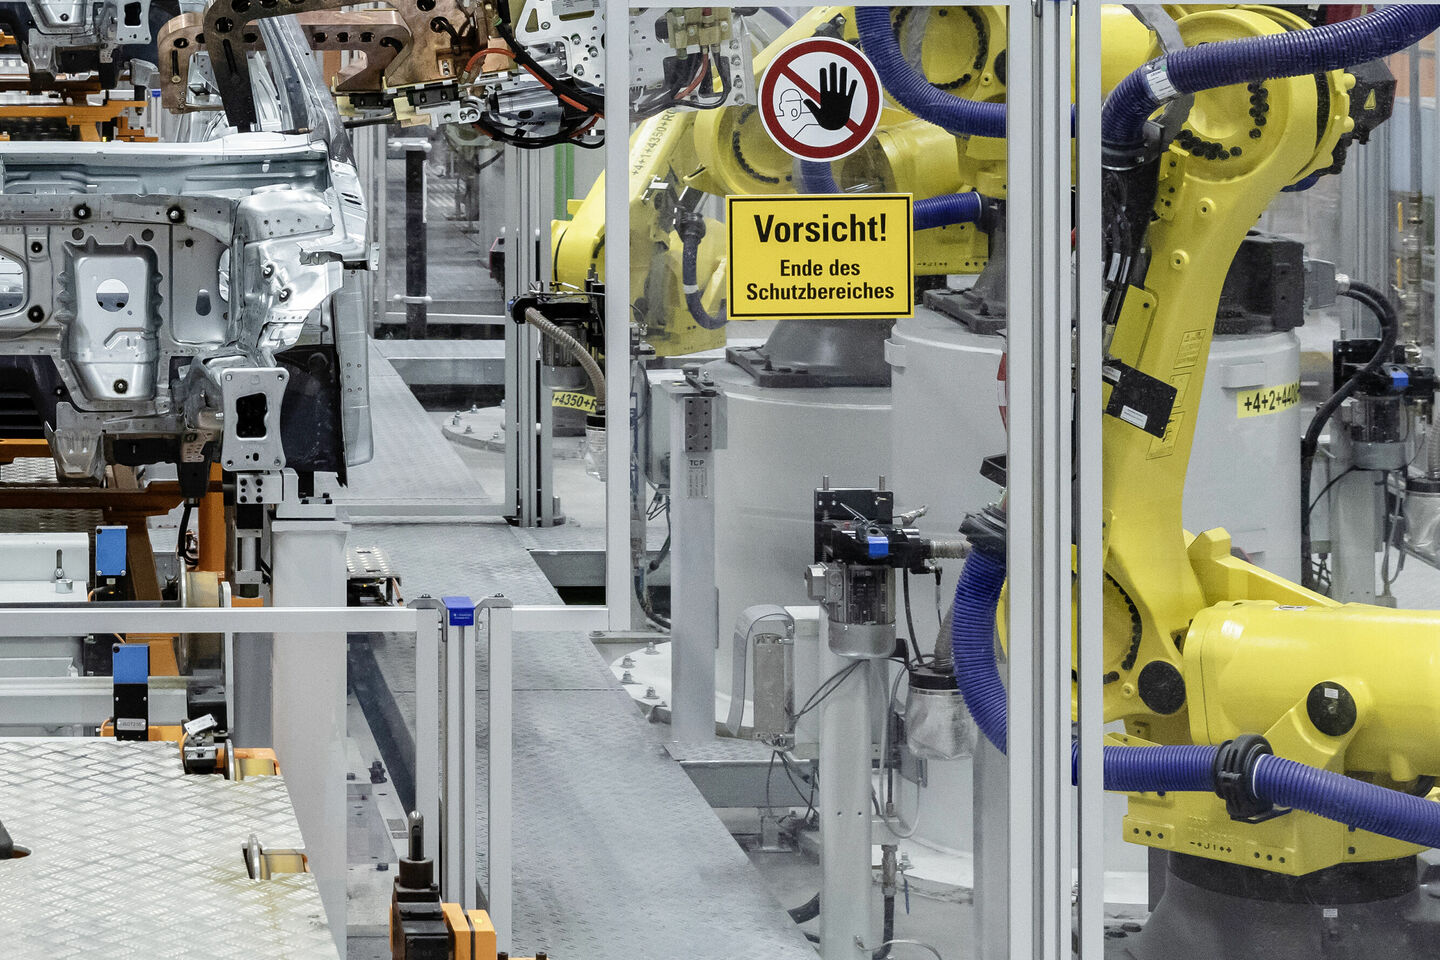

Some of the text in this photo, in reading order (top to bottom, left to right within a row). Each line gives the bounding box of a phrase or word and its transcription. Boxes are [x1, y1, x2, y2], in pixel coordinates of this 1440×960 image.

[753, 213, 886, 243] Vorsicht!
[780, 258, 860, 277] Ende des
[746, 282, 895, 301] Schutzbereiches
